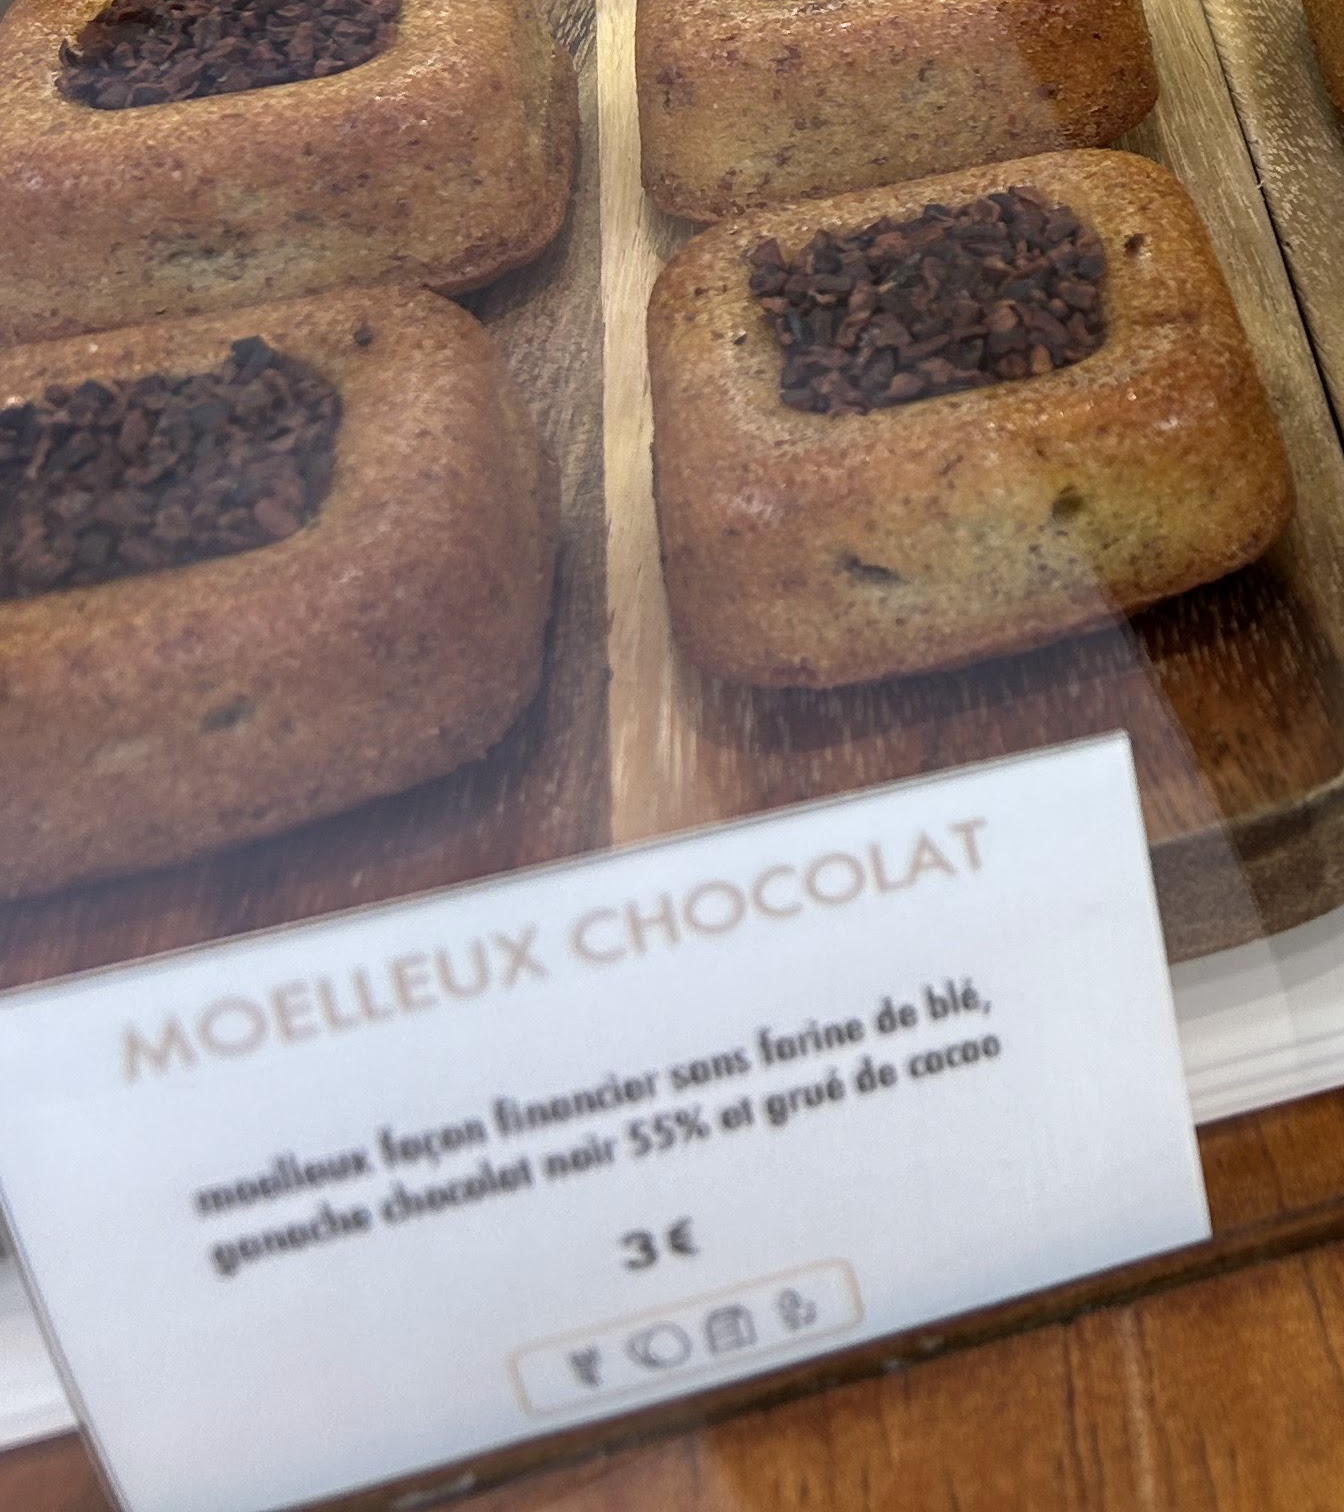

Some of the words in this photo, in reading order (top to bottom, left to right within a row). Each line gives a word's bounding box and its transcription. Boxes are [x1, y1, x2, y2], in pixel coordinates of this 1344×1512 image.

[119, 920, 549, 1085] MOELLEUX
[568, 816, 987, 966] CHOCOLAT
[194, 1150, 374, 1217] moelleux
[377, 1122, 487, 1168] façon
[491, 1071, 658, 1138] financier
[670, 1046, 752, 1090] sans
[757, 1017, 865, 1067] farine
[875, 995, 918, 1035] de
[924, 976, 992, 1021] blé,
[209, 1199, 373, 1278] ganache
[380, 1155, 535, 1224] chocolat
[544, 1132, 616, 1180] noir
[626, 1104, 711, 1158] 55%
[719, 1096, 755, 1131] et
[763, 1067, 846, 1129] grué
[856, 1054, 898, 1094] de
[908, 1033, 1001, 1080] cacao
